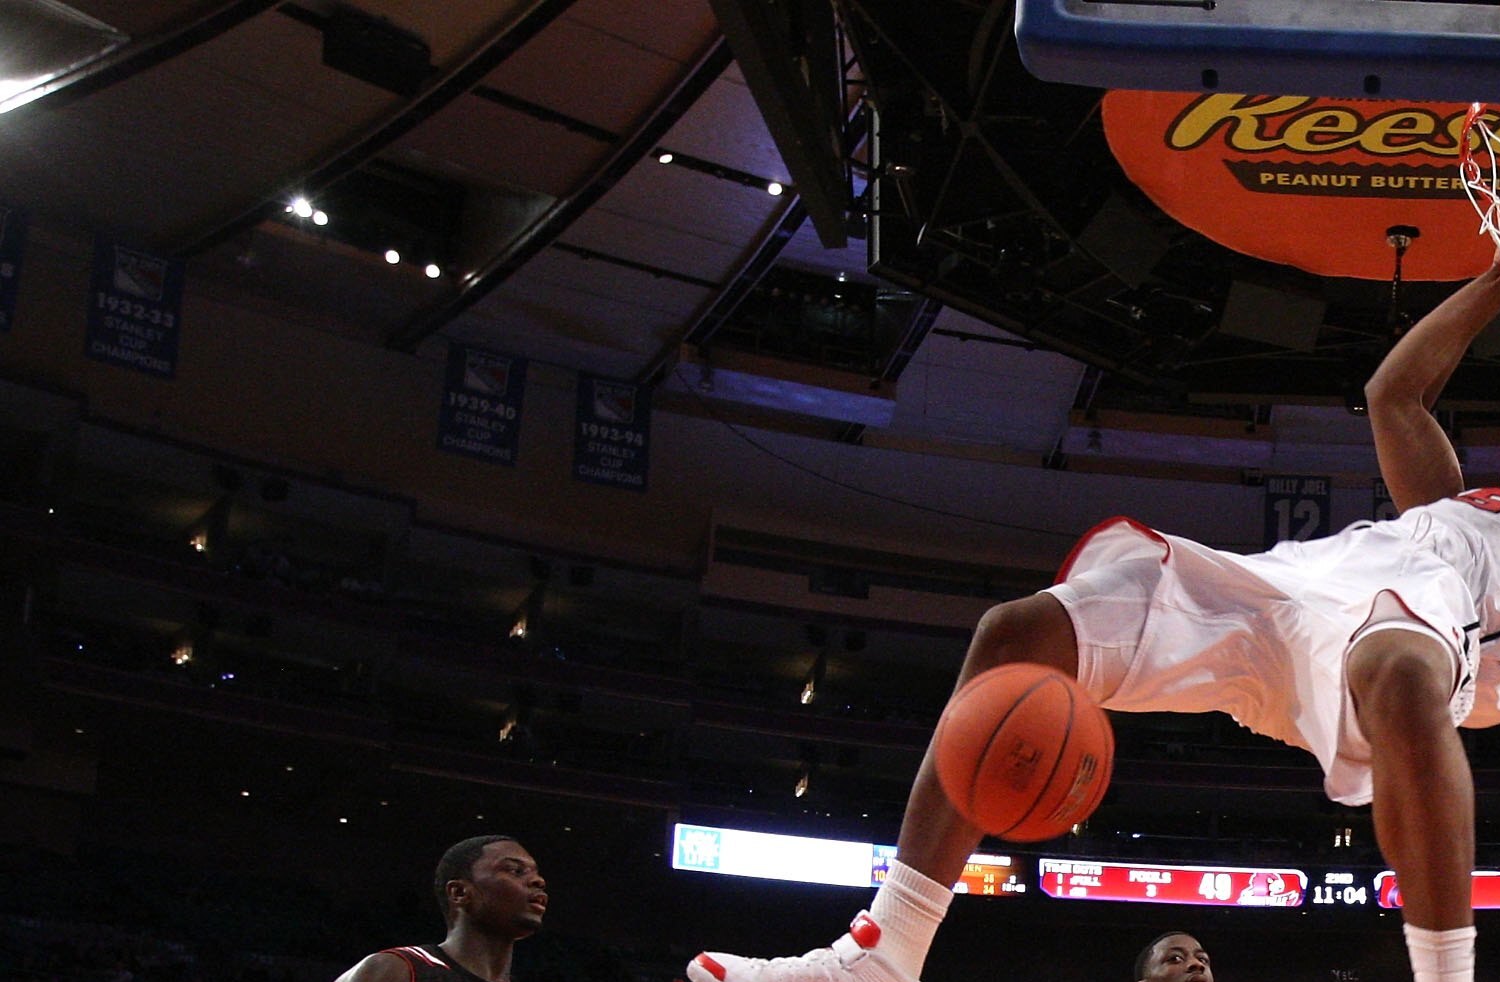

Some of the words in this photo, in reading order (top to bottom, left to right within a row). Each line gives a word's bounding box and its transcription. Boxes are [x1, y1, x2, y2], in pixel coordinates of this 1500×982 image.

[1260, 172, 1361, 188] PEANUT
[1370, 176, 1463, 192] BUTTER
[600, 456, 623, 468] CUP
[1273, 499, 1320, 541] 12
[1313, 886, 1367, 905] 11:04
